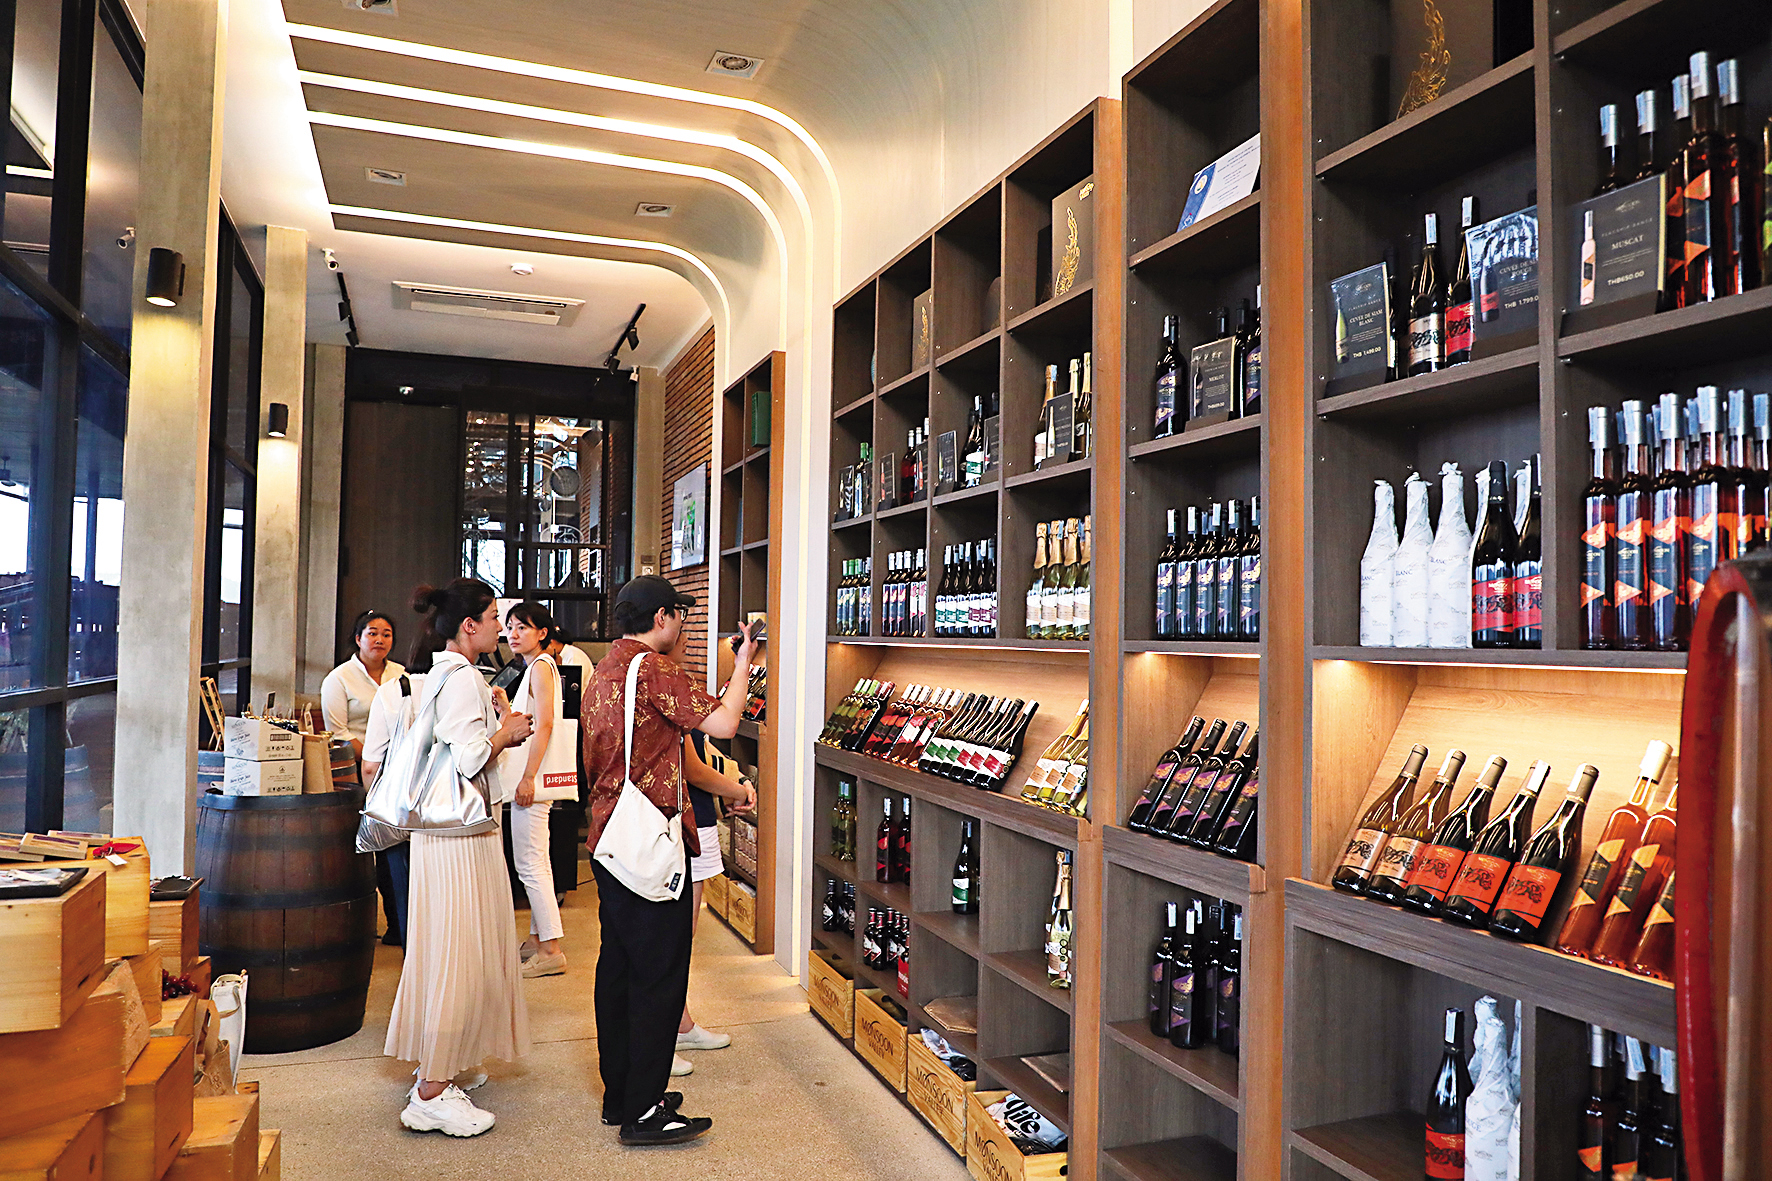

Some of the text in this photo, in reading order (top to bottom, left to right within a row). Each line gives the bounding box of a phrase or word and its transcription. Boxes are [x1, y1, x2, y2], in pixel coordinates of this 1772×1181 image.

[1611, 234, 1644, 250] MUSCAT
[546, 774, 578, 786] Standard
[813, 973, 840, 1007] MONSOON
[861, 1016, 894, 1057] MONSOON
[868, 1038, 886, 1060] VALLEY
[915, 1066, 955, 1115] MONSOON
[974, 1131, 1014, 1181] MONSOON
